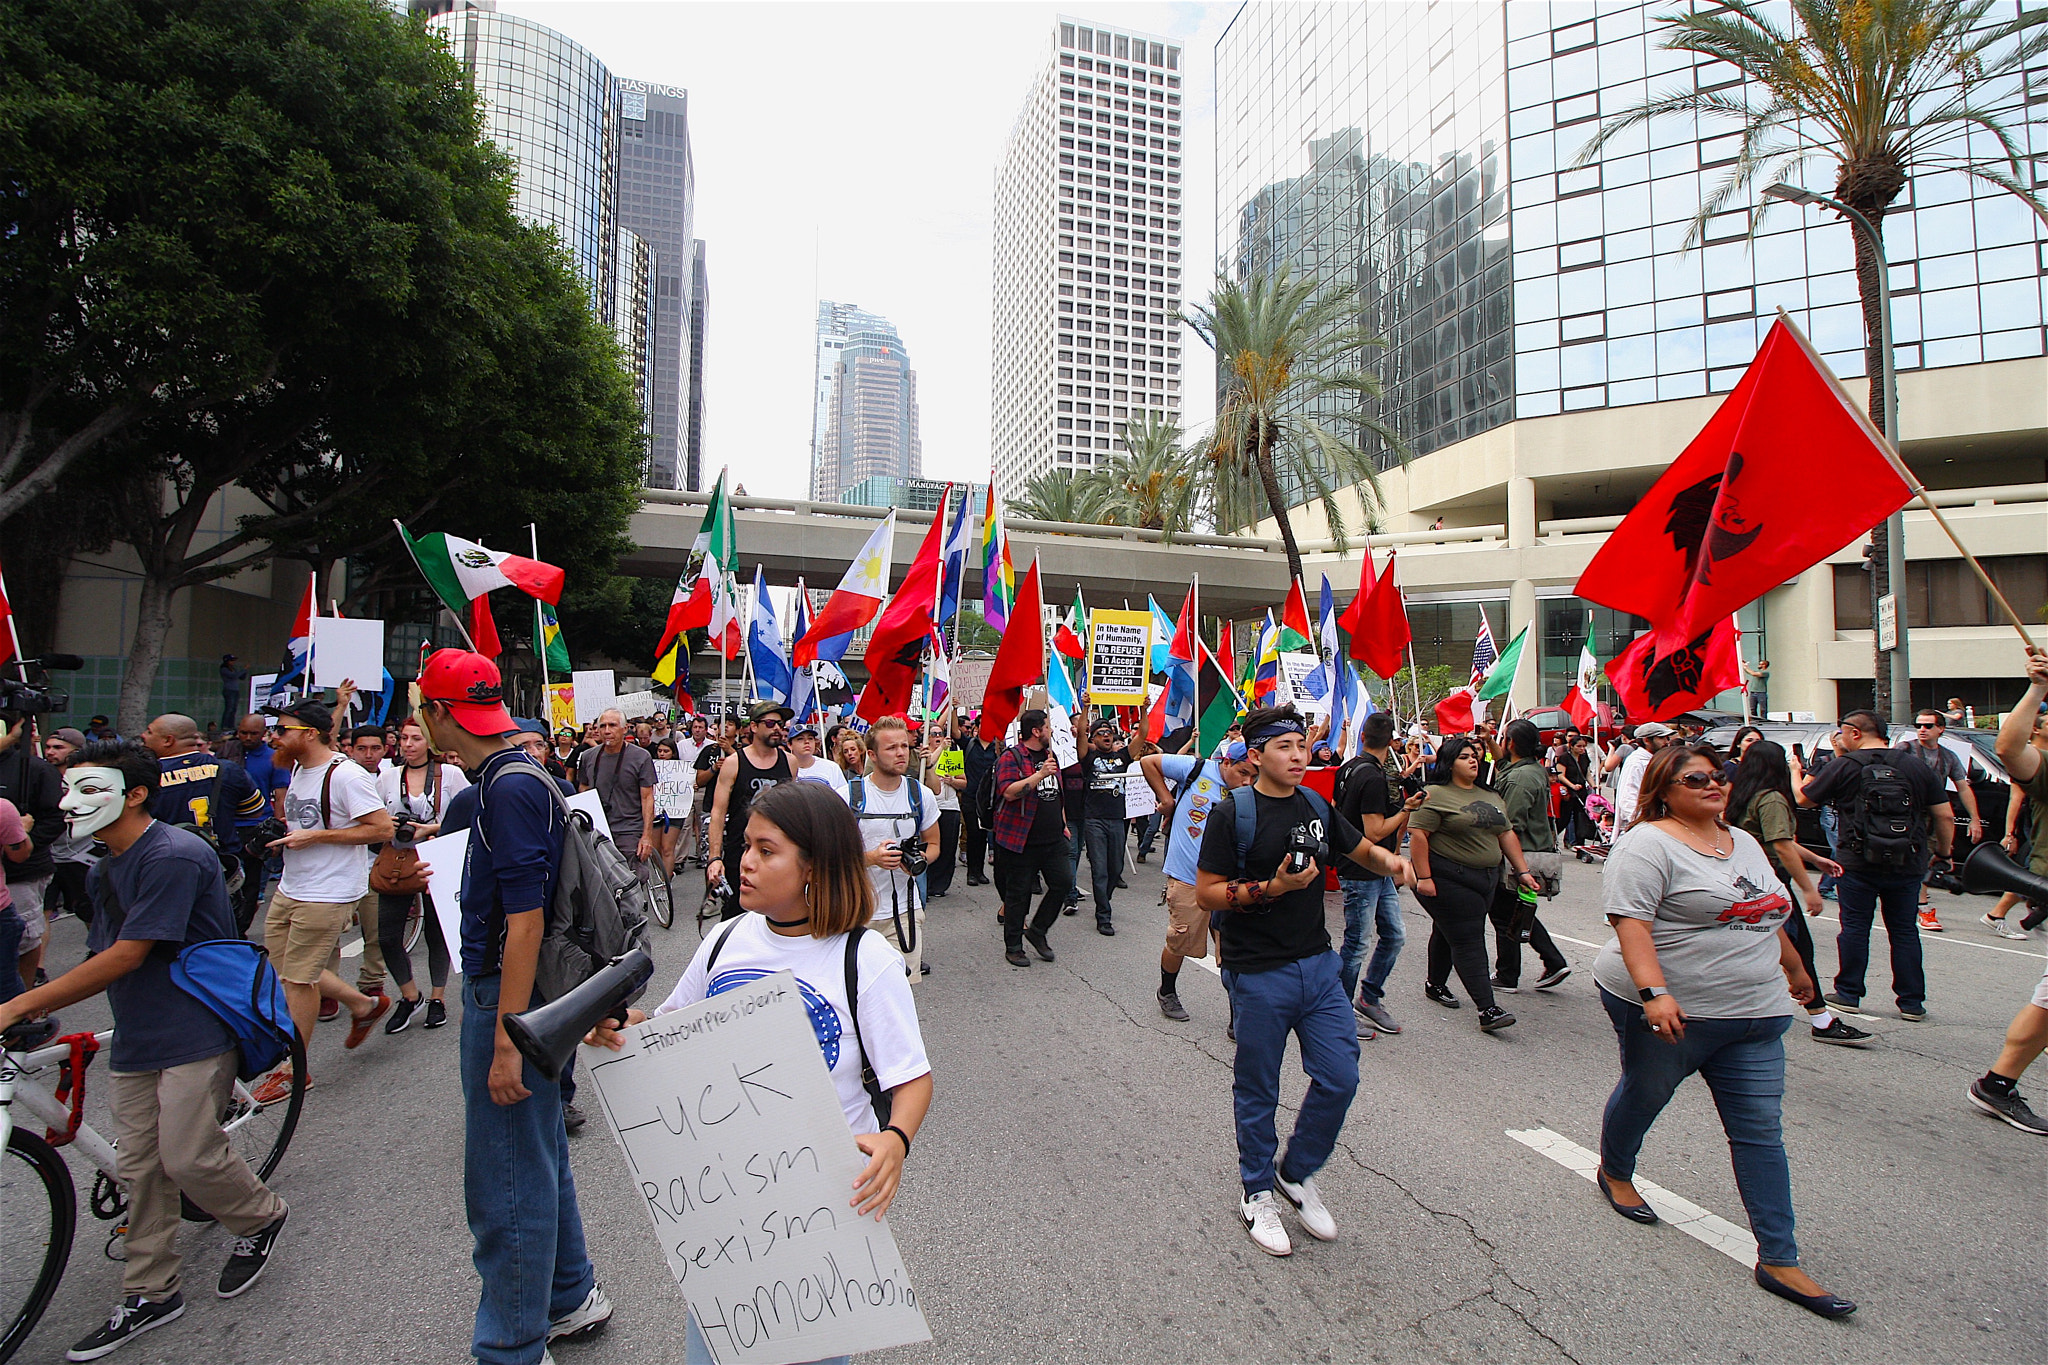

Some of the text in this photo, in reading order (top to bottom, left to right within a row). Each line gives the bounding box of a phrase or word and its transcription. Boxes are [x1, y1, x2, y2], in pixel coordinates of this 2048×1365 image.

[620, 79, 685, 99] HASTINGS
[907, 480, 968, 492] MANUFACRER
[1097, 624, 1142, 634] In the Name
[1096, 633, 1142, 645] of Humanity,
[1097, 645, 1142, 655] We REFUSE
[1101, 655, 1137, 666] To Accept
[955, 664, 981, 676] TRUMP
[1108, 666, 1135, 675] Fascist
[1102, 677, 1133, 686] America
[551, 706, 562, 714] LL
[710, 703, 733, 714] ths
[850, 717, 870, 734] Hat
[653, 760, 696, 774] GRANTS
[654, 795, 678, 807] REAT
[641, 1146, 820, 1225] Racism
